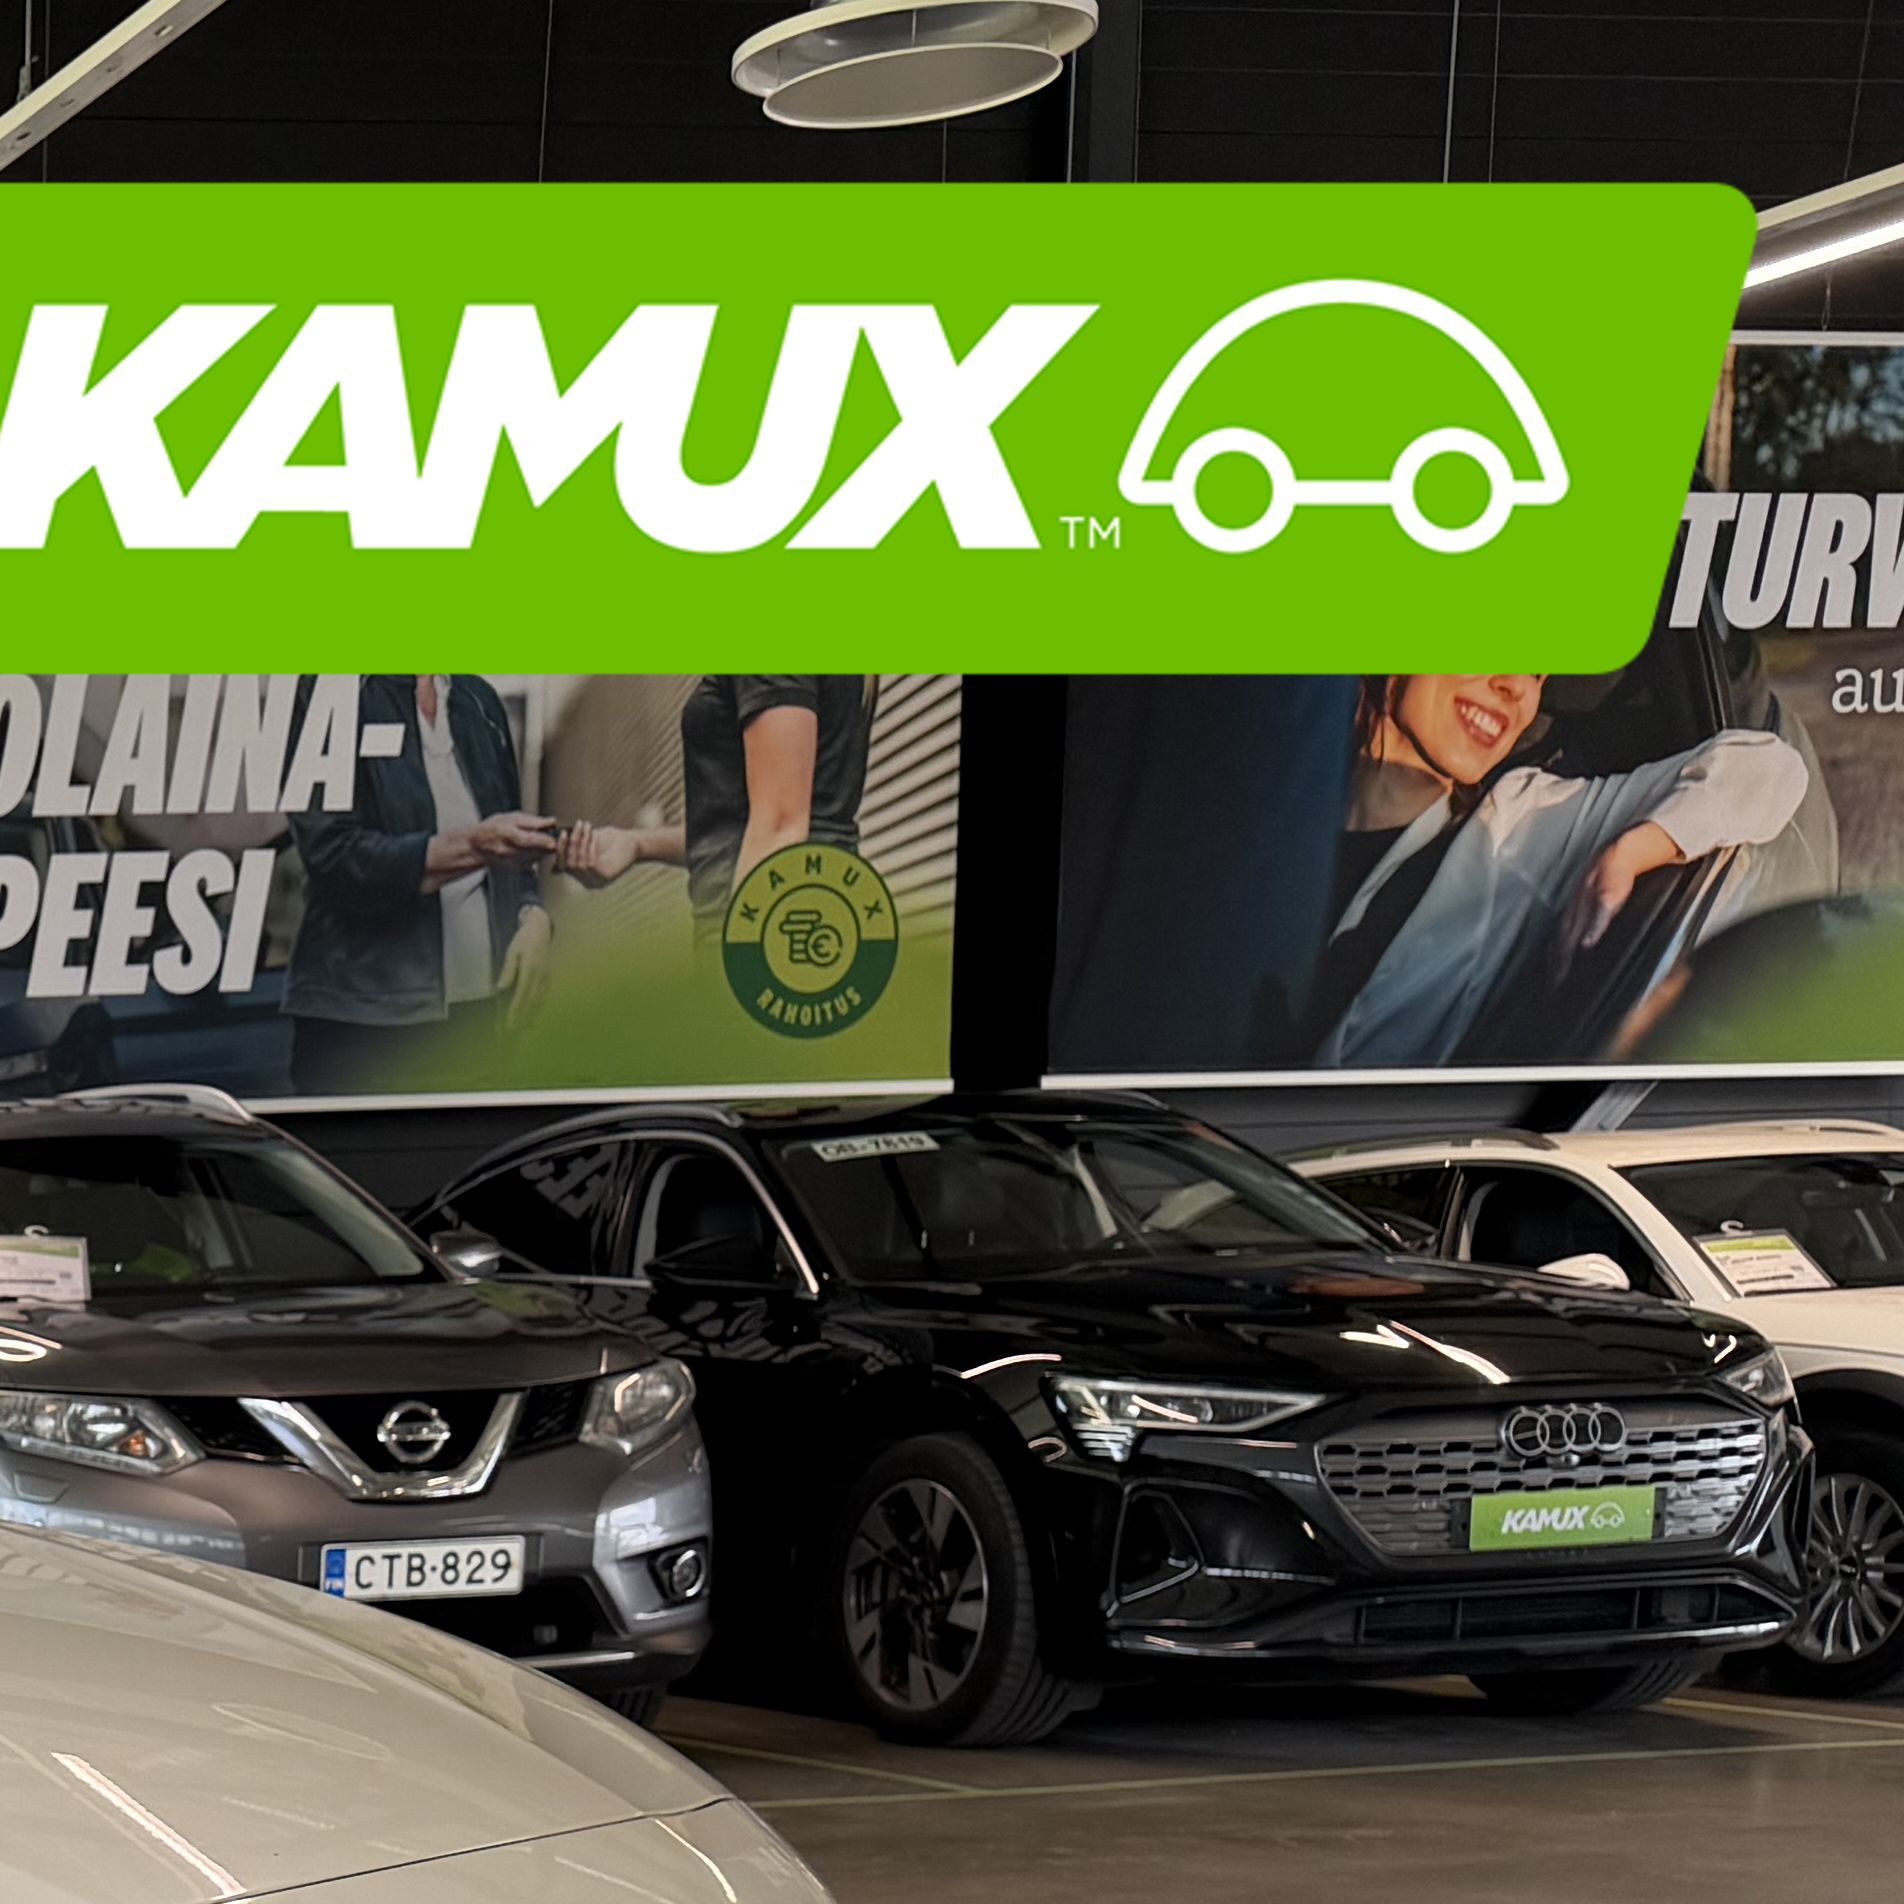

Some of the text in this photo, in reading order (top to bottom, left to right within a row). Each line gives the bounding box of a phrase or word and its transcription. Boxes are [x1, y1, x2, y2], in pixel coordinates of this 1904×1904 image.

[739, 854, 884, 923] KAMUX
[756, 986, 863, 1027] RAHOITUS
[1500, 1505, 1591, 1535] KAMUX
